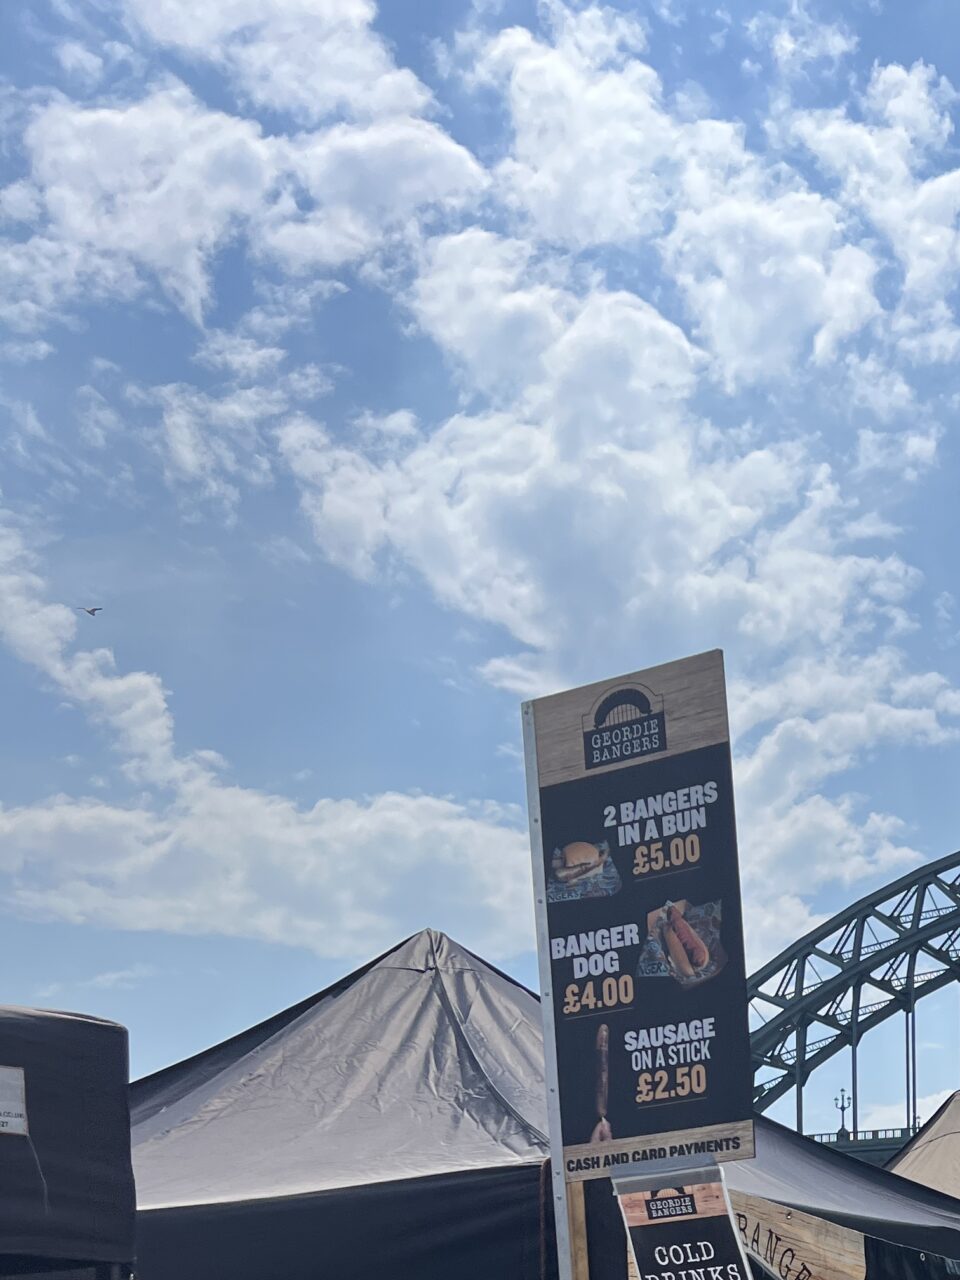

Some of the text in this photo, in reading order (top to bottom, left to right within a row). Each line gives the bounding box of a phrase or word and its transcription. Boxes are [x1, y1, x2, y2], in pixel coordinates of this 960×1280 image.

[591, 718, 659, 748] GEORDIE
[592, 734, 660, 763] BANGERS
[603, 781, 718, 828] 2 BANGERS
[617, 806, 706, 847] IN A BUN
[632, 834, 700, 876] £5.00
[551, 923, 640, 961] BANGER
[573, 951, 620, 979] DOG
[562, 974, 634, 1015] £4.00
[624, 1017, 715, 1051] SAUSAGE
[631, 1040, 711, 1071] ON A STICK
[635, 1064, 707, 1103] £2.50
[566, 1136, 741, 1172] CASH AND CARD PAYMENTS
[650, 1196, 691, 1210] GEORDIE
[651, 1204, 693, 1217] BANGERS
[654, 1241, 715, 1266] COLD
